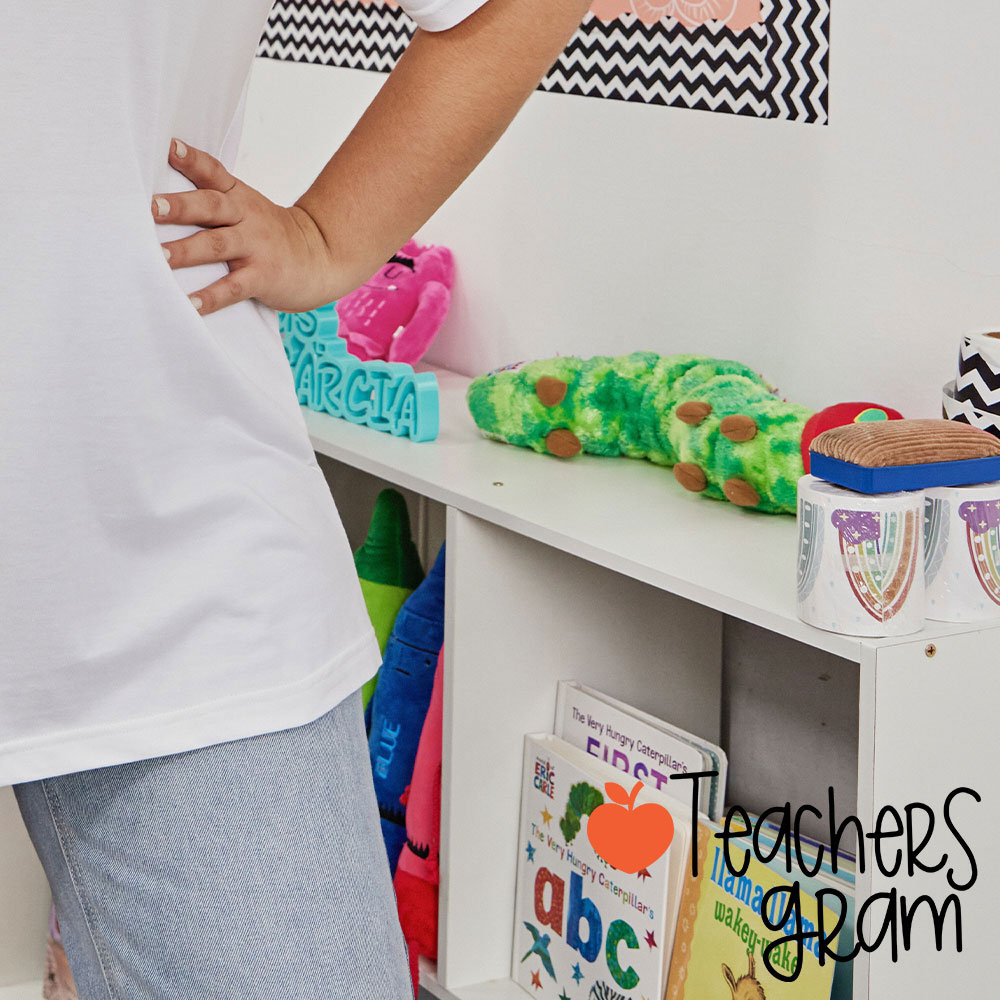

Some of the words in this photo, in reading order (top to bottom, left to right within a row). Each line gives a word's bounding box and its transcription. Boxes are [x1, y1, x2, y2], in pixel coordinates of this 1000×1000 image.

[289, 352, 418, 436] ARCIA
[375, 718, 401, 780] BLUE
[535, 760, 556, 786] ERIC
[571, 706, 586, 724] The
[586, 713, 604, 735] Very
[606, 725, 635, 751] Hungry
[636, 738, 689, 775] Caterpillar's
[533, 775, 556, 800] CARLE
[531, 822, 545, 843] The
[546, 834, 566, 861] Very
[566, 848, 598, 884] Hungry
[598, 872, 655, 920] Caterpillar's
[533, 865, 641, 991] abc
